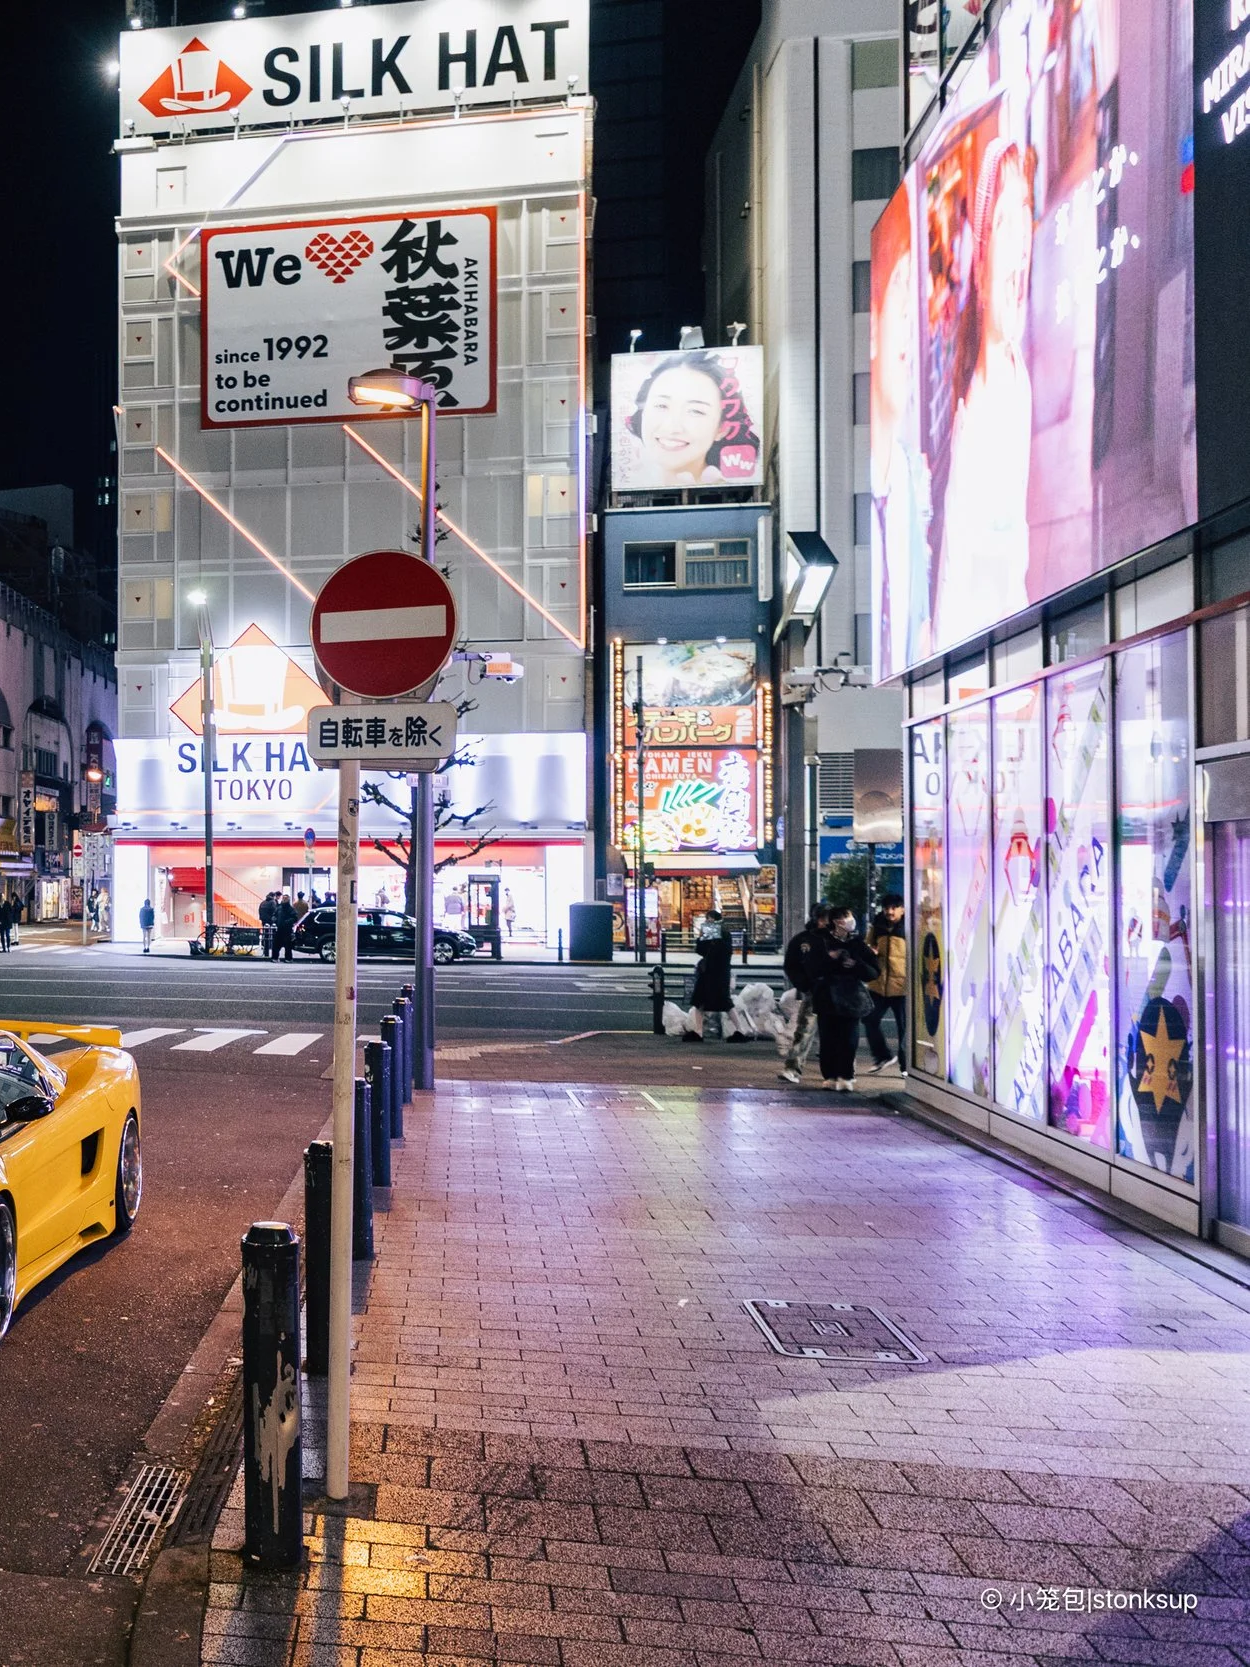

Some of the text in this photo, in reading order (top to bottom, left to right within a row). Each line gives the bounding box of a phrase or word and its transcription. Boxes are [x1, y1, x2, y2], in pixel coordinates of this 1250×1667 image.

[263, 19, 570, 107] SILK HAT
[215, 247, 302, 289] We
[463, 257, 479, 367] AKIHABARA
[215, 335, 329, 365] since 1992
[215, 371, 271, 390] to be
[215, 389, 328, 413] continued
[719, 357, 741, 441] ワクワク
[319, 716, 442, 748] 自転車を除く
[643, 724, 733, 743] ハンバーグ
[266, 741, 324, 773] HA
[628, 758, 713, 773] RAMEN
[214, 779, 293, 801] TOKYO
